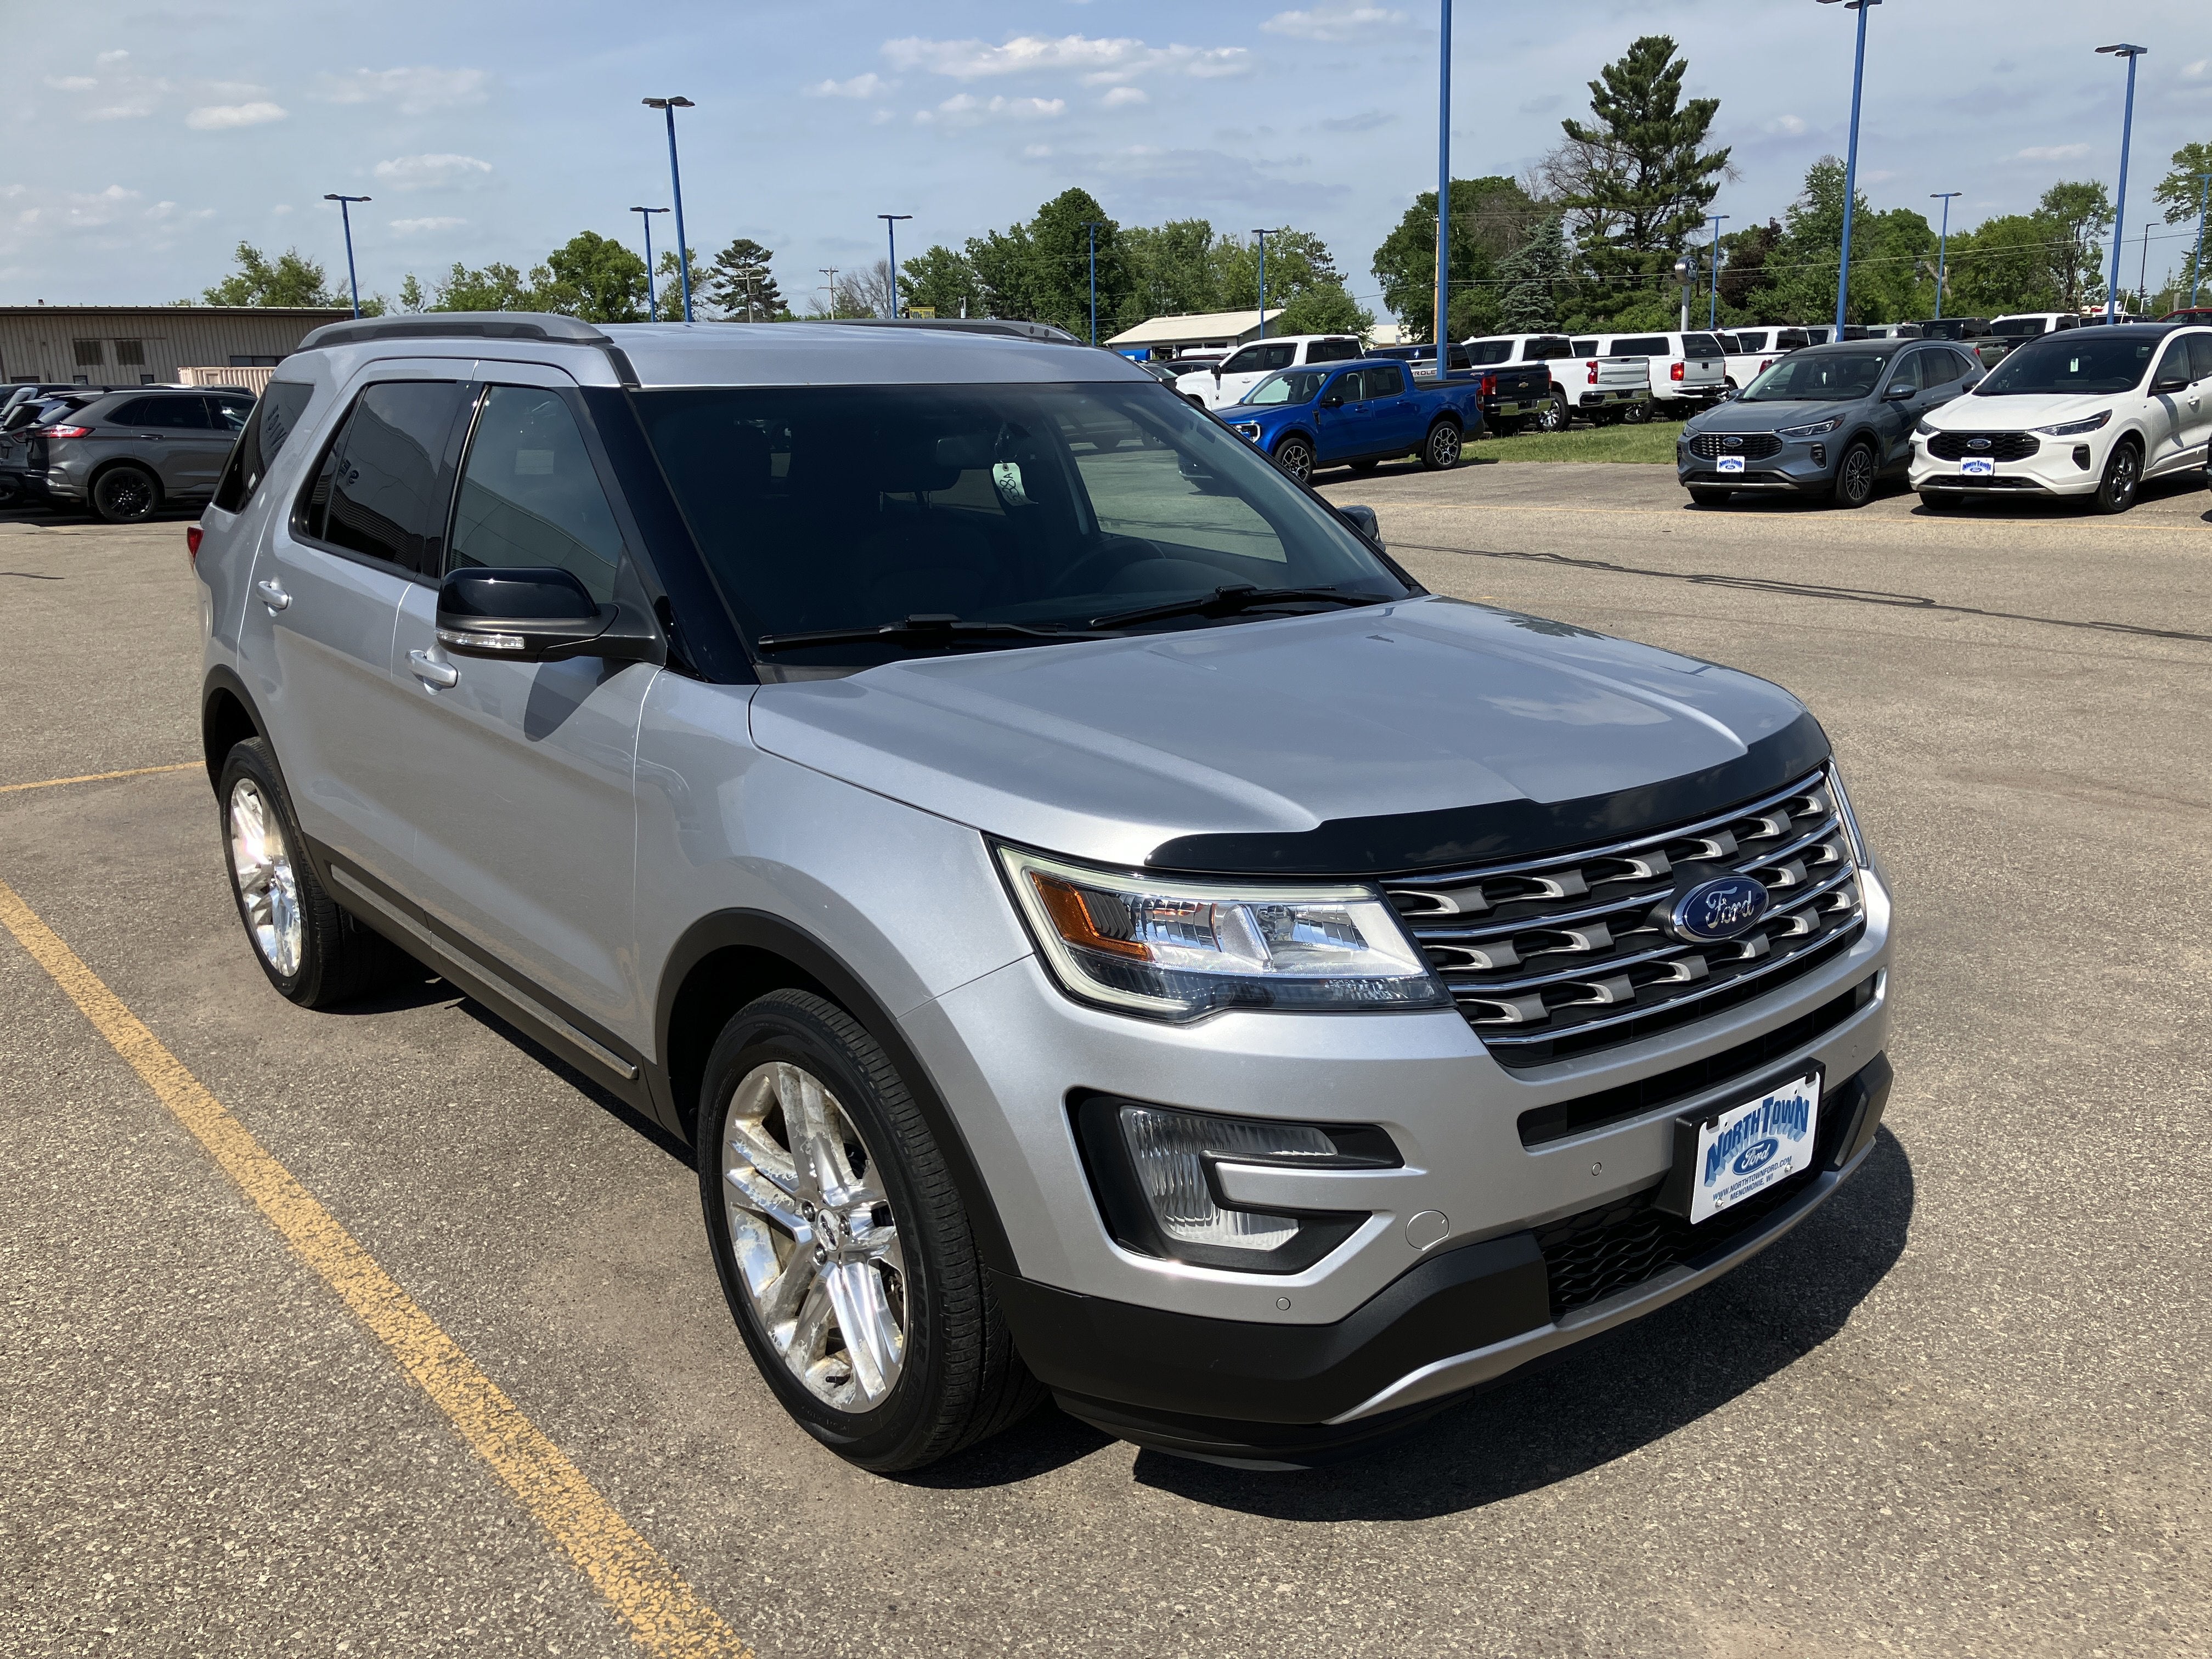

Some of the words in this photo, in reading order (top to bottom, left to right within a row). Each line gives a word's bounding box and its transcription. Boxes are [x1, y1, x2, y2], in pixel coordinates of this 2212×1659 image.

[1706, 886, 1754, 929] Ford
[1741, 1143, 1770, 1169] Ford
[1712, 1155, 1792, 1201] WWW.NORTHTOWNFORD.COM
[1730, 1178, 1765, 1201] MENOMONIE,
[1766, 1173, 1774, 1183] WI
